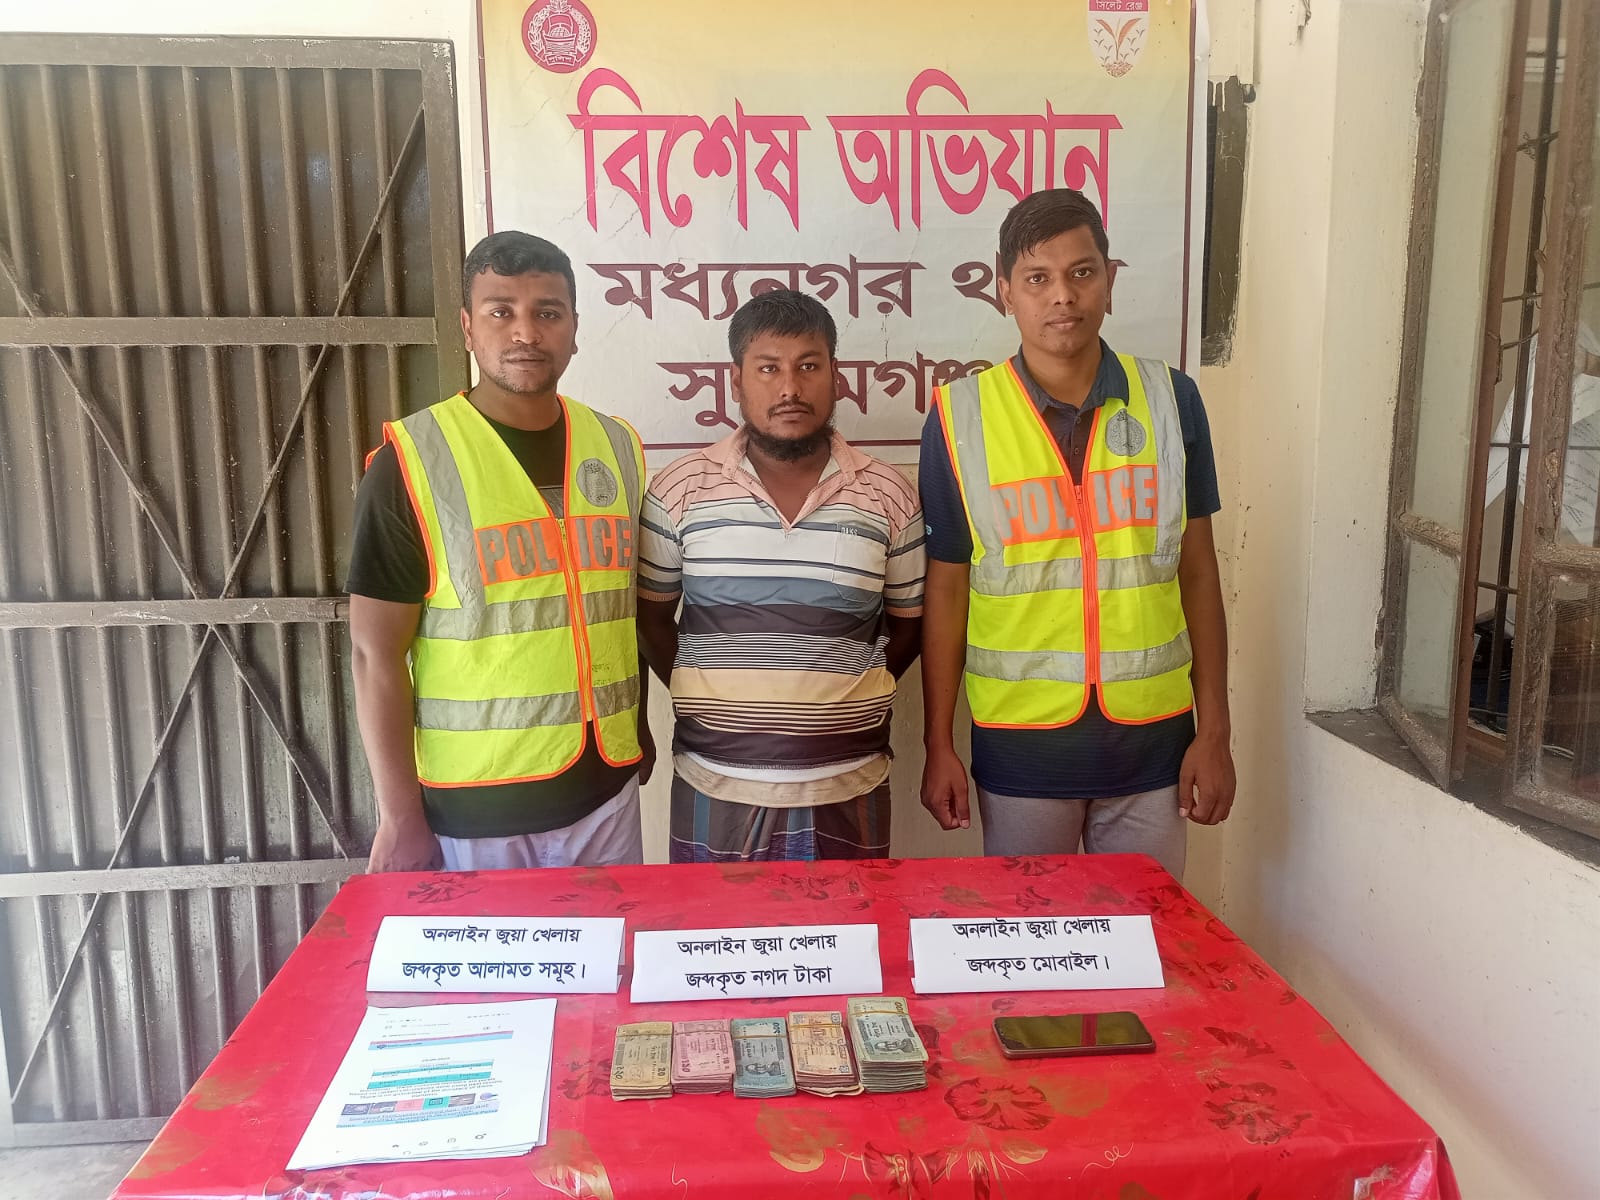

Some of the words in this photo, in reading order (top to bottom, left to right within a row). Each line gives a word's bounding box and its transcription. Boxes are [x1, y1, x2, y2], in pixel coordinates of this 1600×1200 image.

[566, 68, 812, 237] বিশেষ
[827, 68, 1123, 231] অভিযান
[991, 467, 1154, 539] POLICE
[478, 518, 632, 582] POLICE
[422, 924, 491, 943] অনলাইন
[496, 927, 528, 946] জুয়া
[532, 928, 582, 943] খেলায়
[952, 917, 1021, 939] অনলাইন
[1025, 919, 1058, 940] জুয়া
[1063, 918, 1112, 936] খেলায়
[677, 936, 746, 956] অনলাইন
[750, 936, 784, 956] জুয়া
[789, 934, 838, 952] খেলায়
[402, 962, 463, 986] জব্দকৃত
[468, 960, 534, 980] আলামত
[685, 970, 748, 994] জব্দকৃত
[751, 968, 790, 986] নগদ
[793, 963, 833, 985] টাকা
[966, 957, 1027, 979] জব্দকৃত
[657, 1067, 666, 1077] 20
